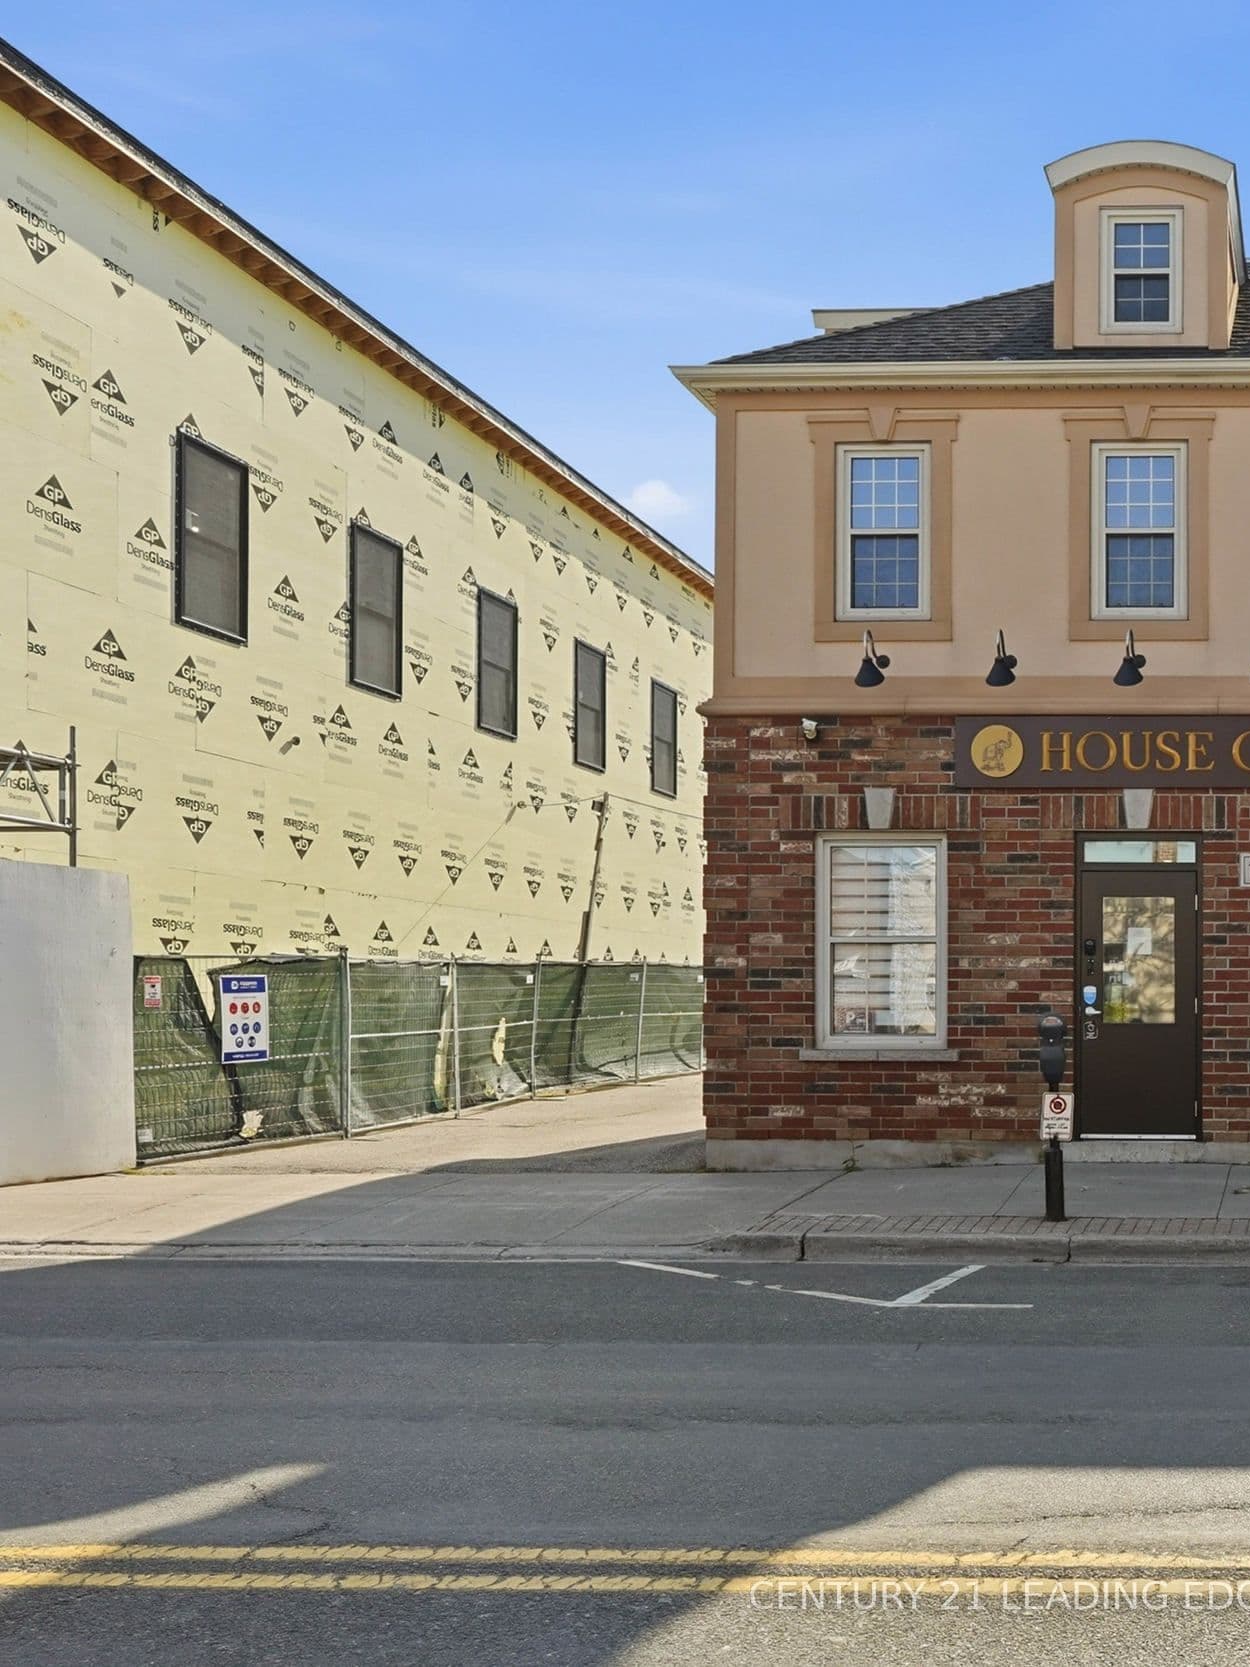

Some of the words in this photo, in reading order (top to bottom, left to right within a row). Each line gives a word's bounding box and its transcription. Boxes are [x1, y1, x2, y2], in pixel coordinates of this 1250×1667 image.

[26, 500, 82, 533] DensGlass
[84, 656, 135, 682] DensGlass
[1040, 731, 1215, 772] HOUSE
